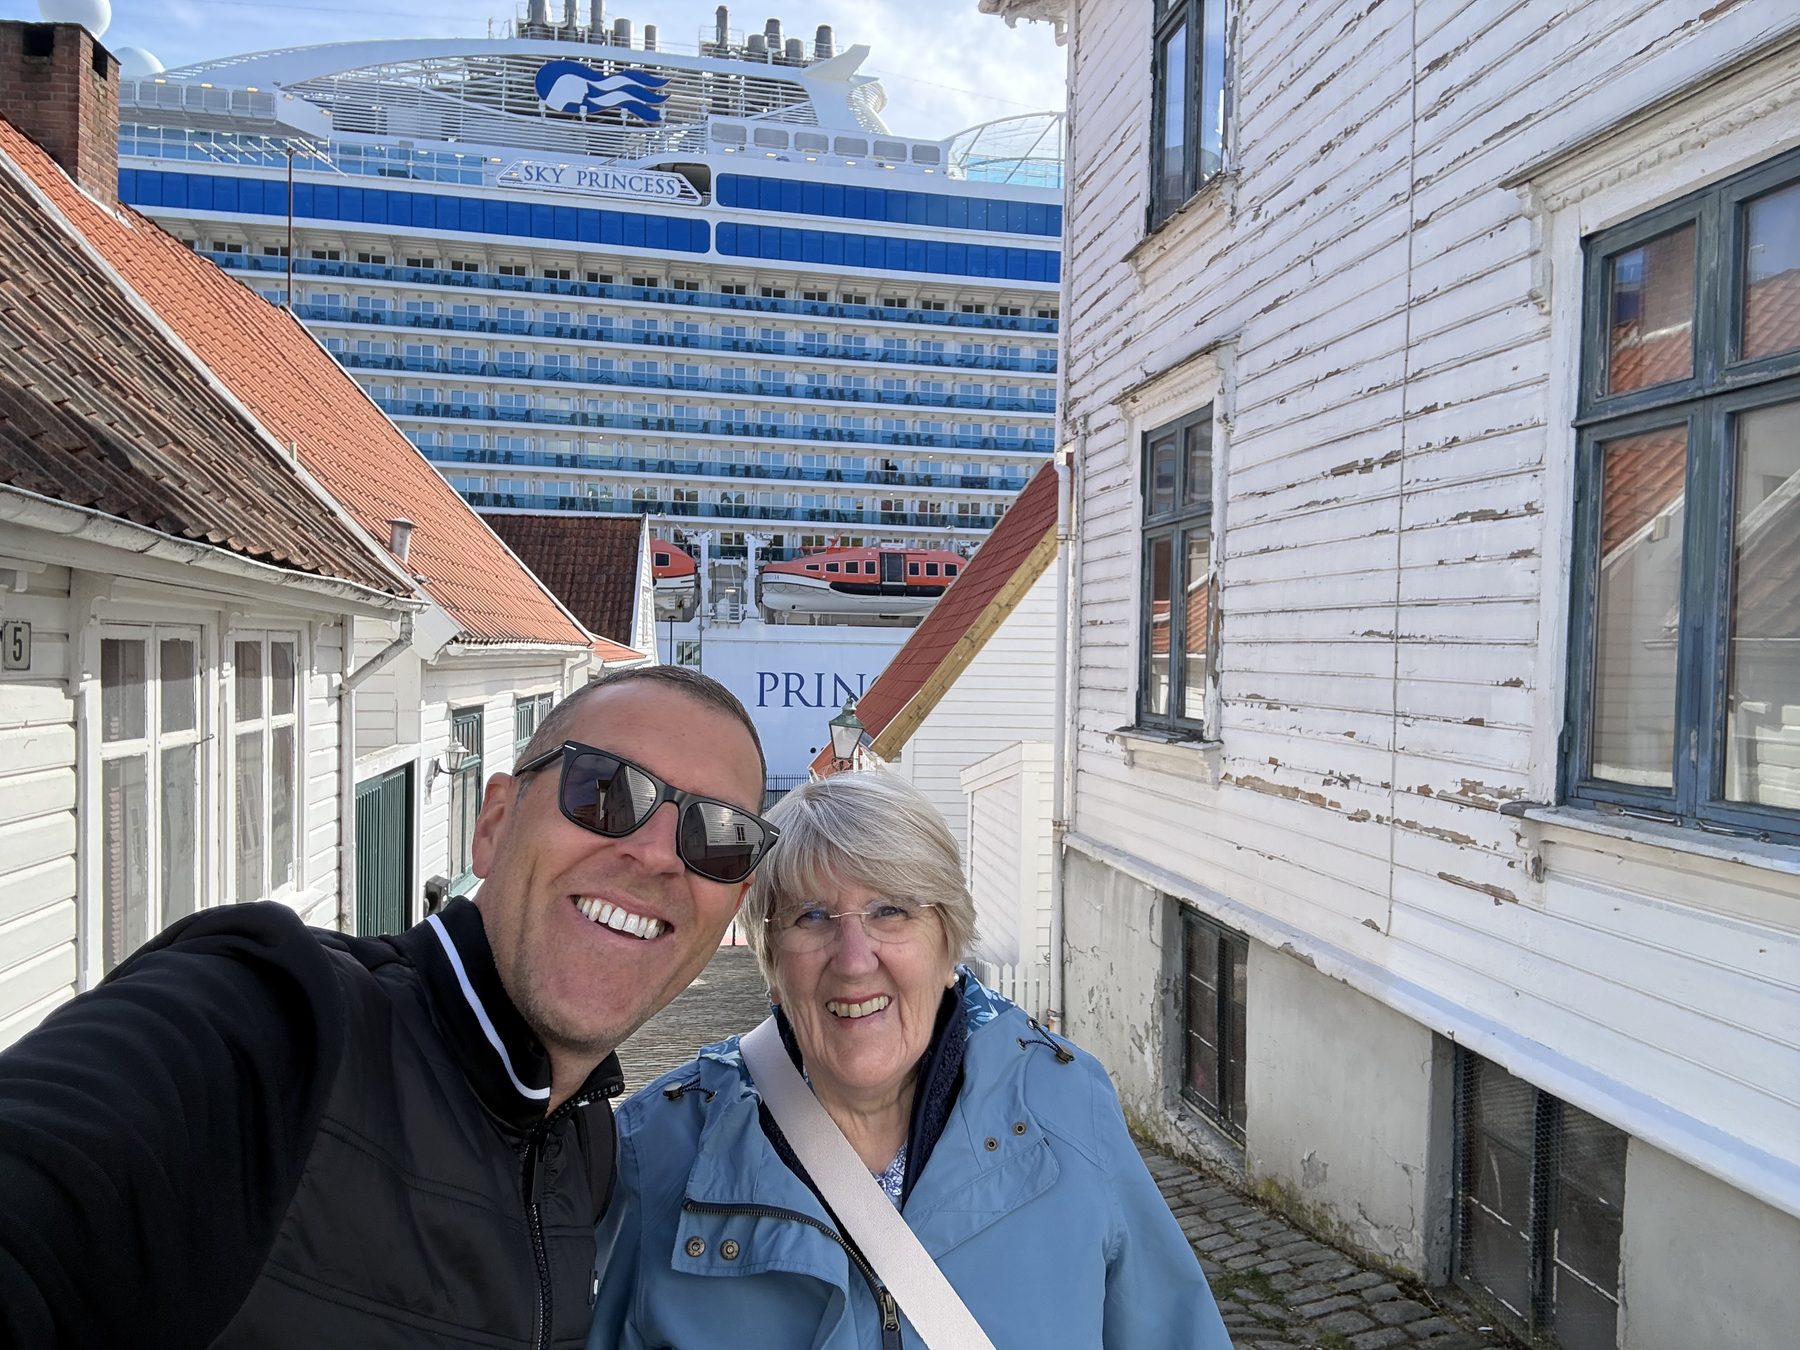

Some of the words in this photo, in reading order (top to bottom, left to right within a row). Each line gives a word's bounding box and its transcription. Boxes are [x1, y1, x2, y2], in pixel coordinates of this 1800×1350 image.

[524, 165, 565, 183] SKY
[576, 170, 675, 195] PRINCESS
[13, 626, 23, 662] 5
[756, 671, 881, 708] PRIN
